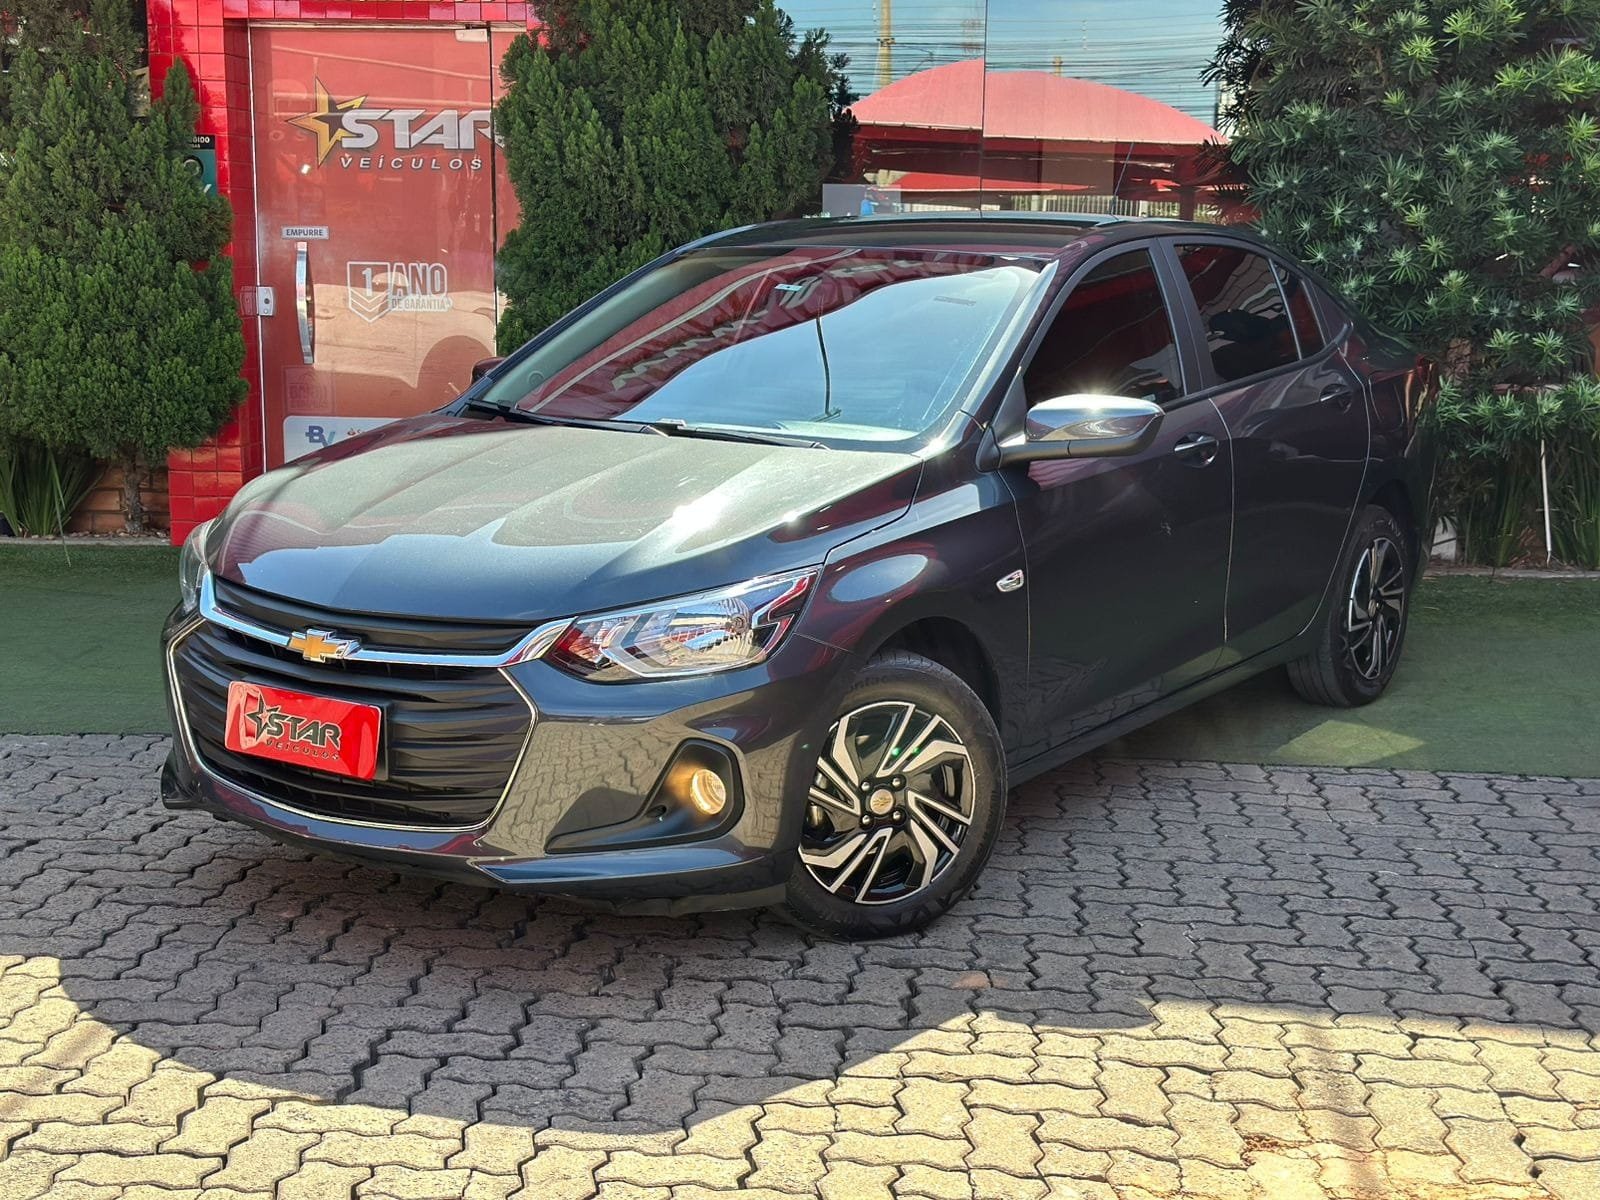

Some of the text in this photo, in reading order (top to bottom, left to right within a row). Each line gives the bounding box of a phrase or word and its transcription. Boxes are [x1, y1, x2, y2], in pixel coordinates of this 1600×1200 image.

[341, 109, 504, 149] STAR
[340, 155, 482, 170] VEÍCULOS
[286, 228, 324, 236] EMPURRE
[361, 262, 448, 297] 1 ANO
[391, 298, 403, 310] DE
[266, 711, 342, 750] STAR
